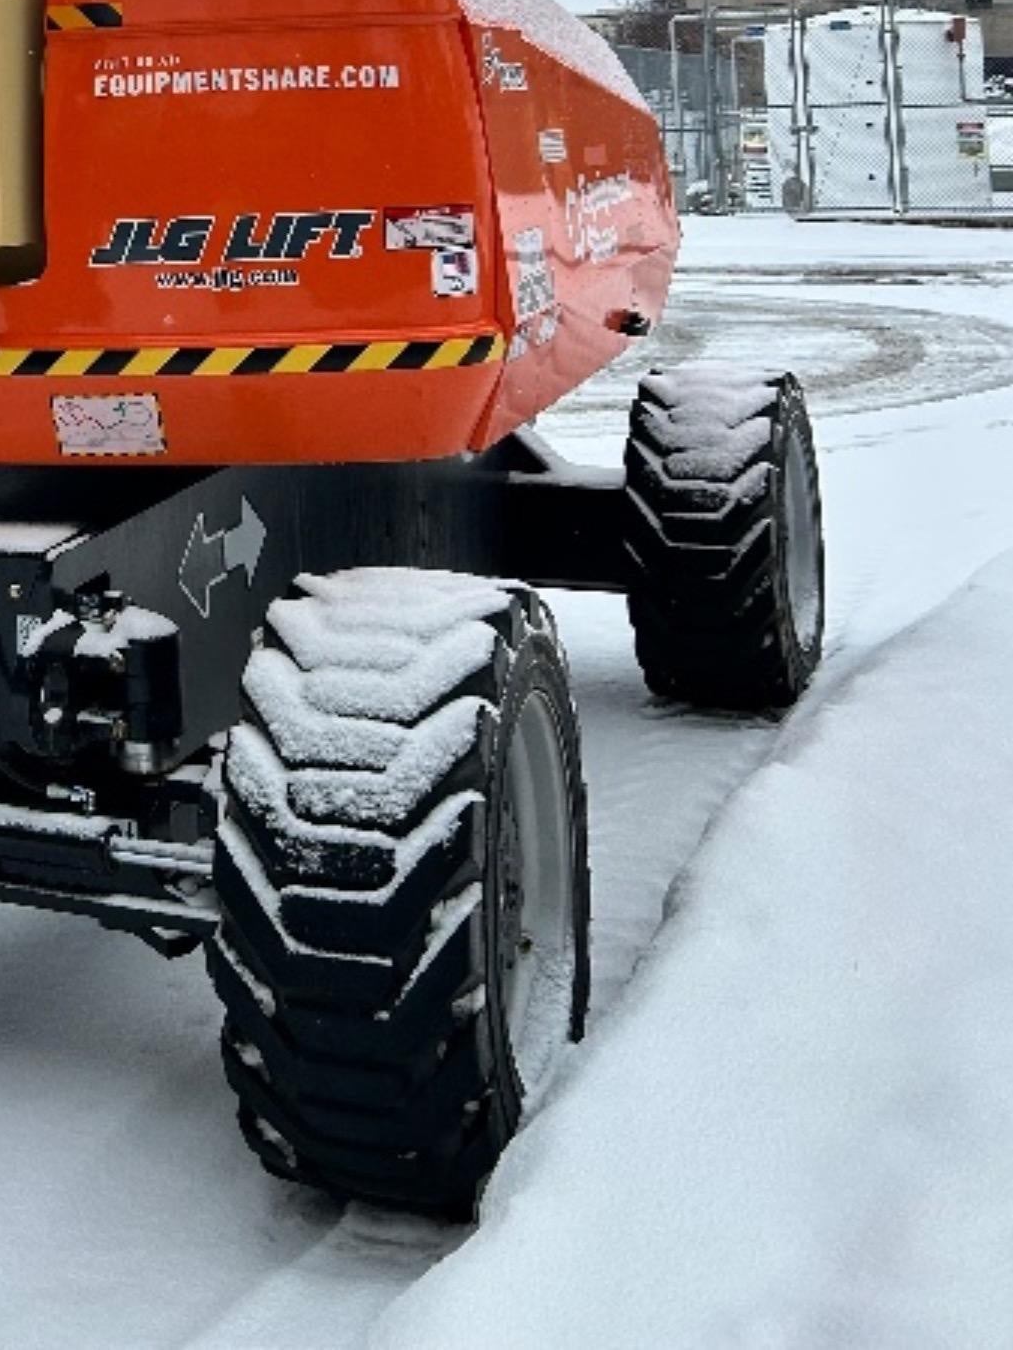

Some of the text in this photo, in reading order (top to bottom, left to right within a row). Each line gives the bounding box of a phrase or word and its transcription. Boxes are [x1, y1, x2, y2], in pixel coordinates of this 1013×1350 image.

[93, 63, 400, 98] EQUIPMENTSHARE.COM
[88, 215, 215, 267] JLG
[220, 209, 379, 263] LIFT
